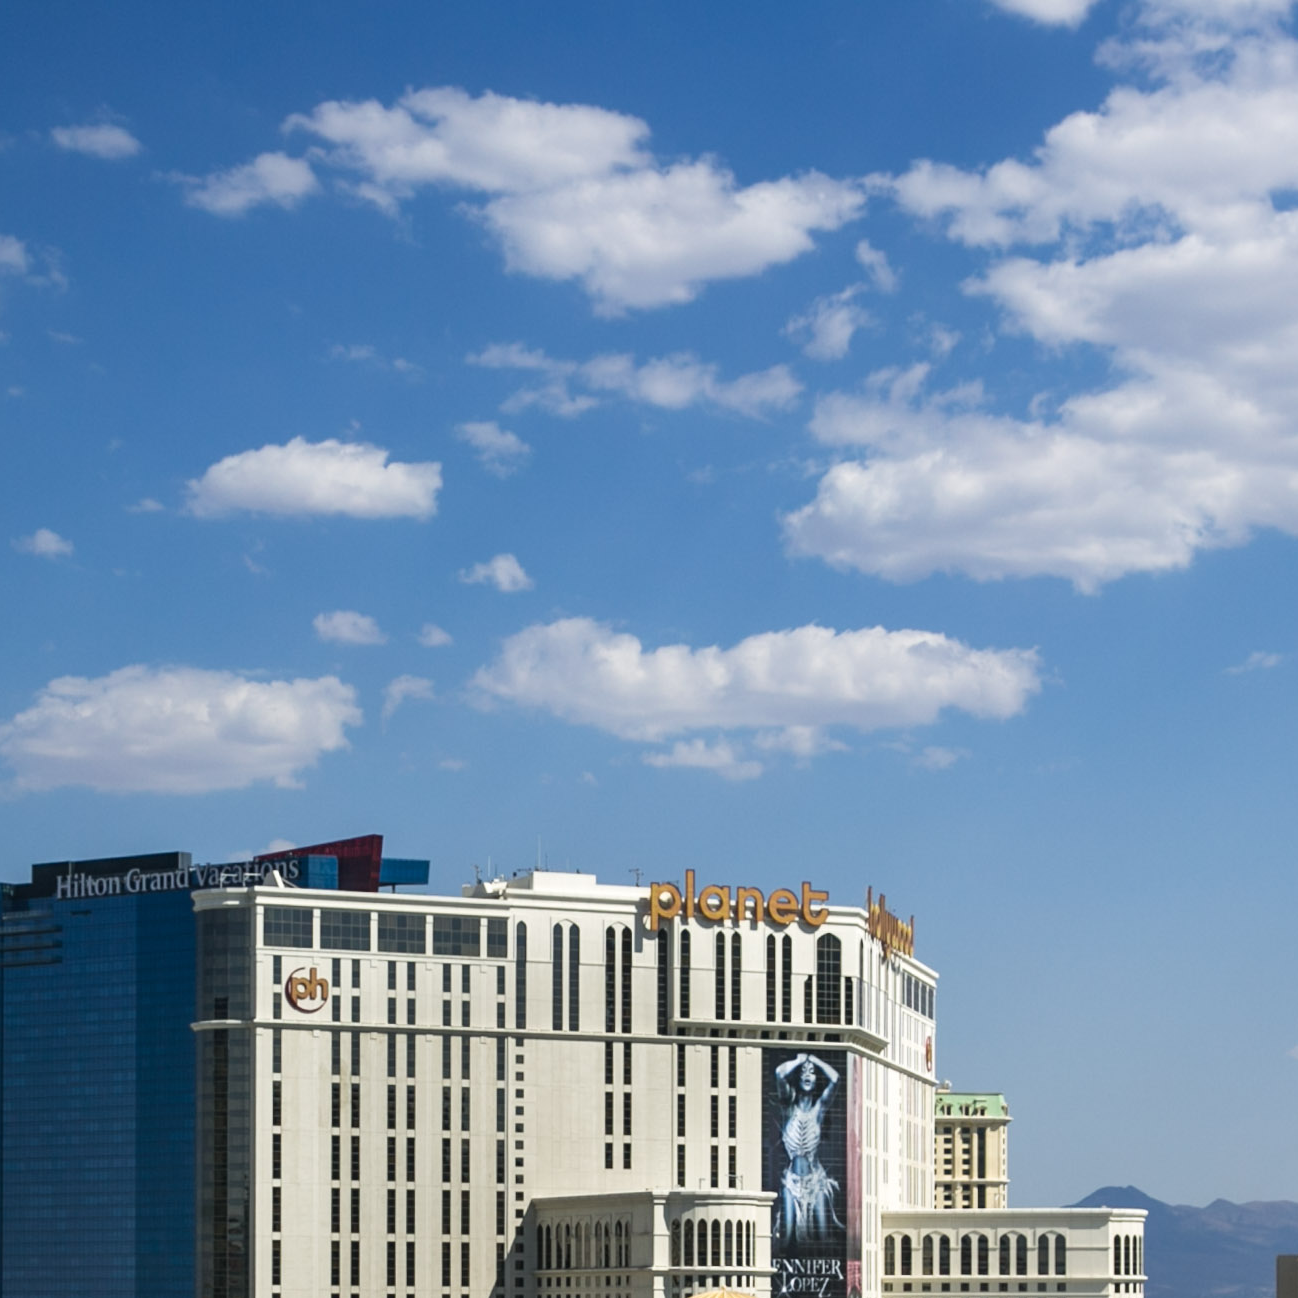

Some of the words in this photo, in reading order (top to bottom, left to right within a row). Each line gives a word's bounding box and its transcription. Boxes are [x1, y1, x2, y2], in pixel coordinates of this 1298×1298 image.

[56, 870, 121, 899] Hilton
[125, 867, 190, 893] Grand
[196, 856, 299, 889] Vacations
[650, 868, 830, 931] planet
[290, 967, 329, 1008] ph
[771, 1258, 844, 1280] ENNIFER
[781, 1271, 831, 1298] LOPEZ
